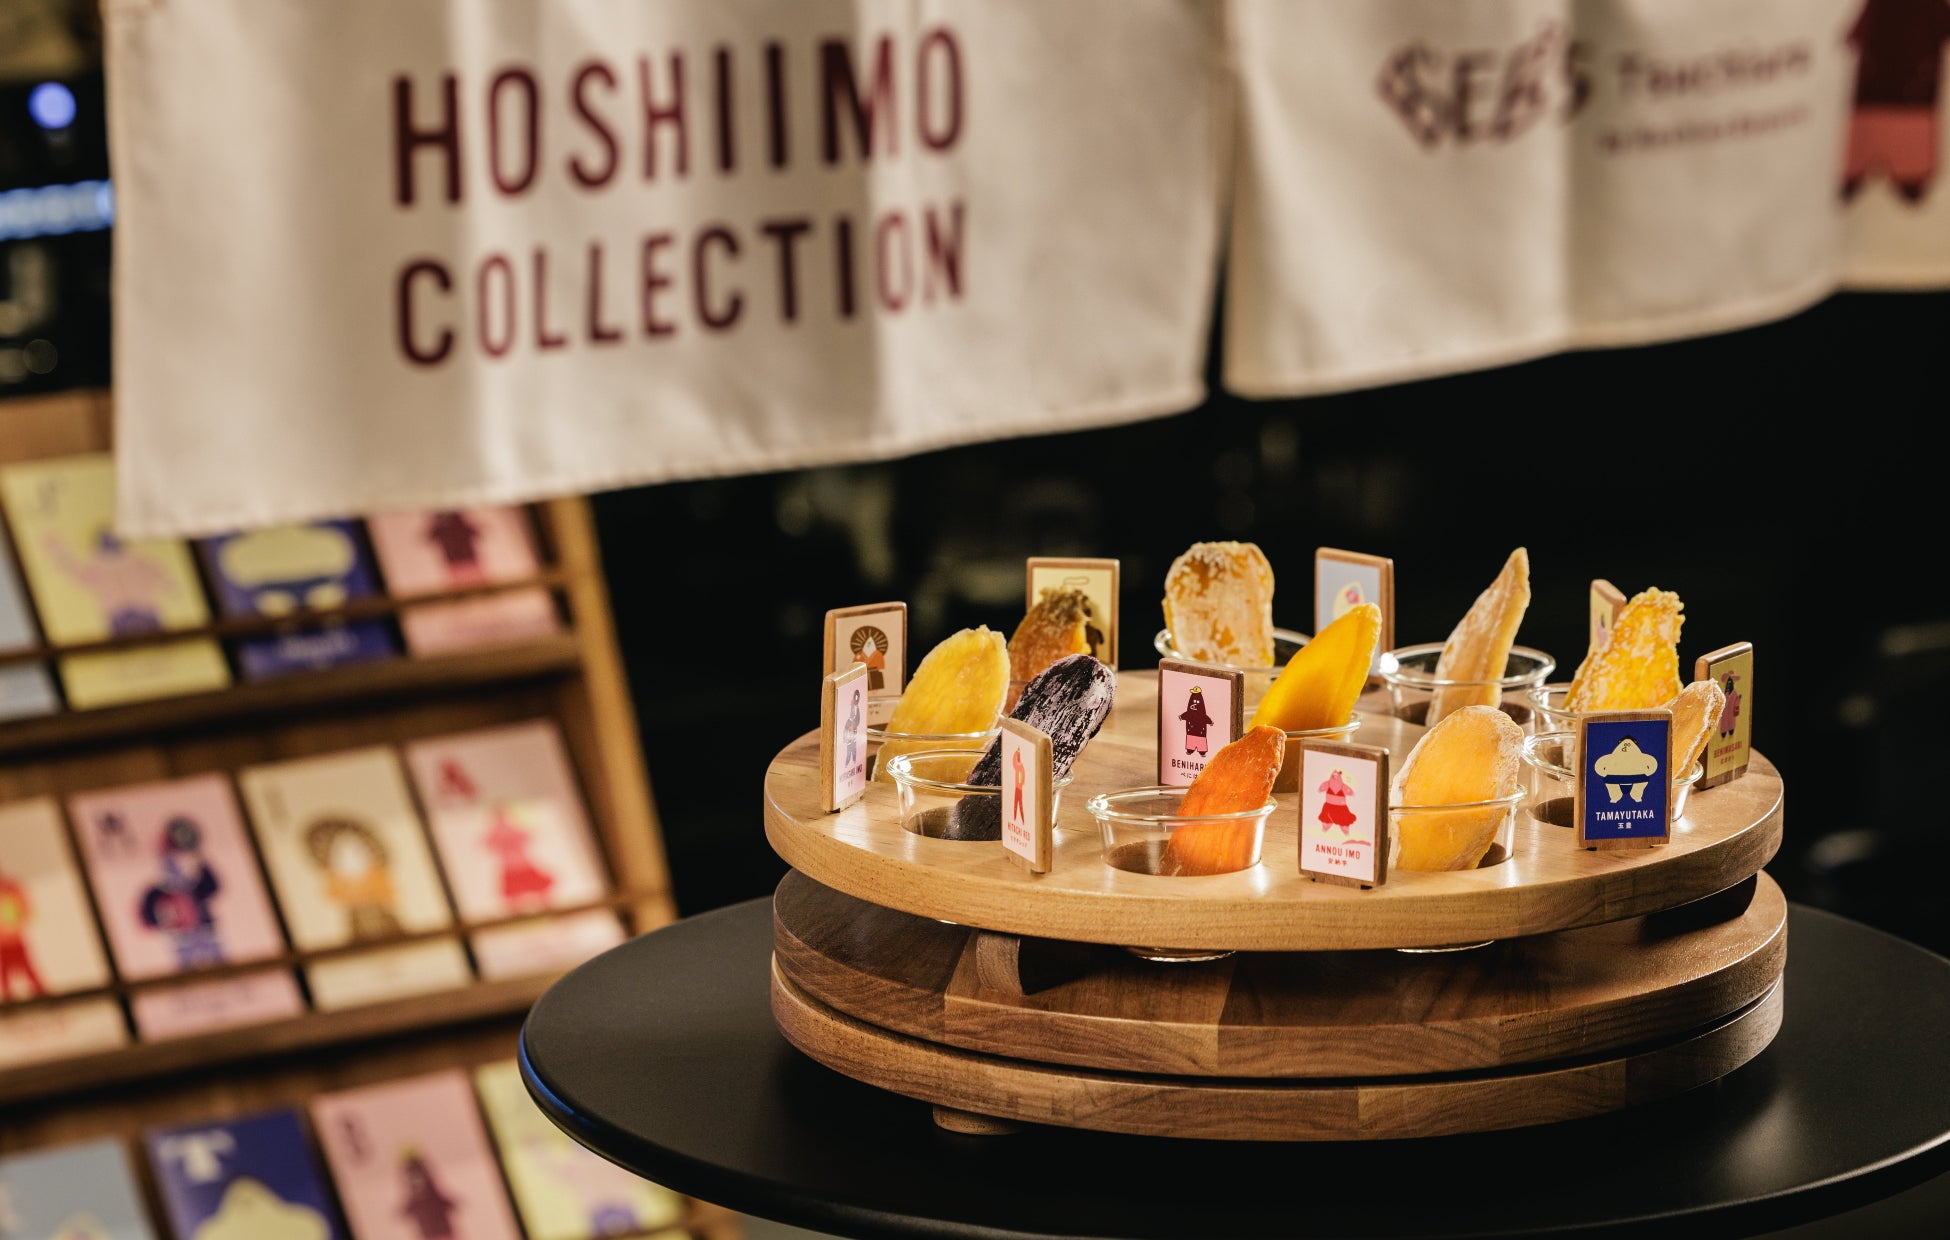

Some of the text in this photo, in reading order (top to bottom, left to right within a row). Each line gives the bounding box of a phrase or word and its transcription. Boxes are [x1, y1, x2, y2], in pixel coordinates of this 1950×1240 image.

[394, 27, 966, 207] HOSHIIMO
[396, 203, 966, 369] COLLECTION
[1171, 758, 1207, 772] BENIHAR
[1595, 809, 1655, 821] TAMAYUTAKA
[1315, 843, 1361, 860] ANNOU IMO
